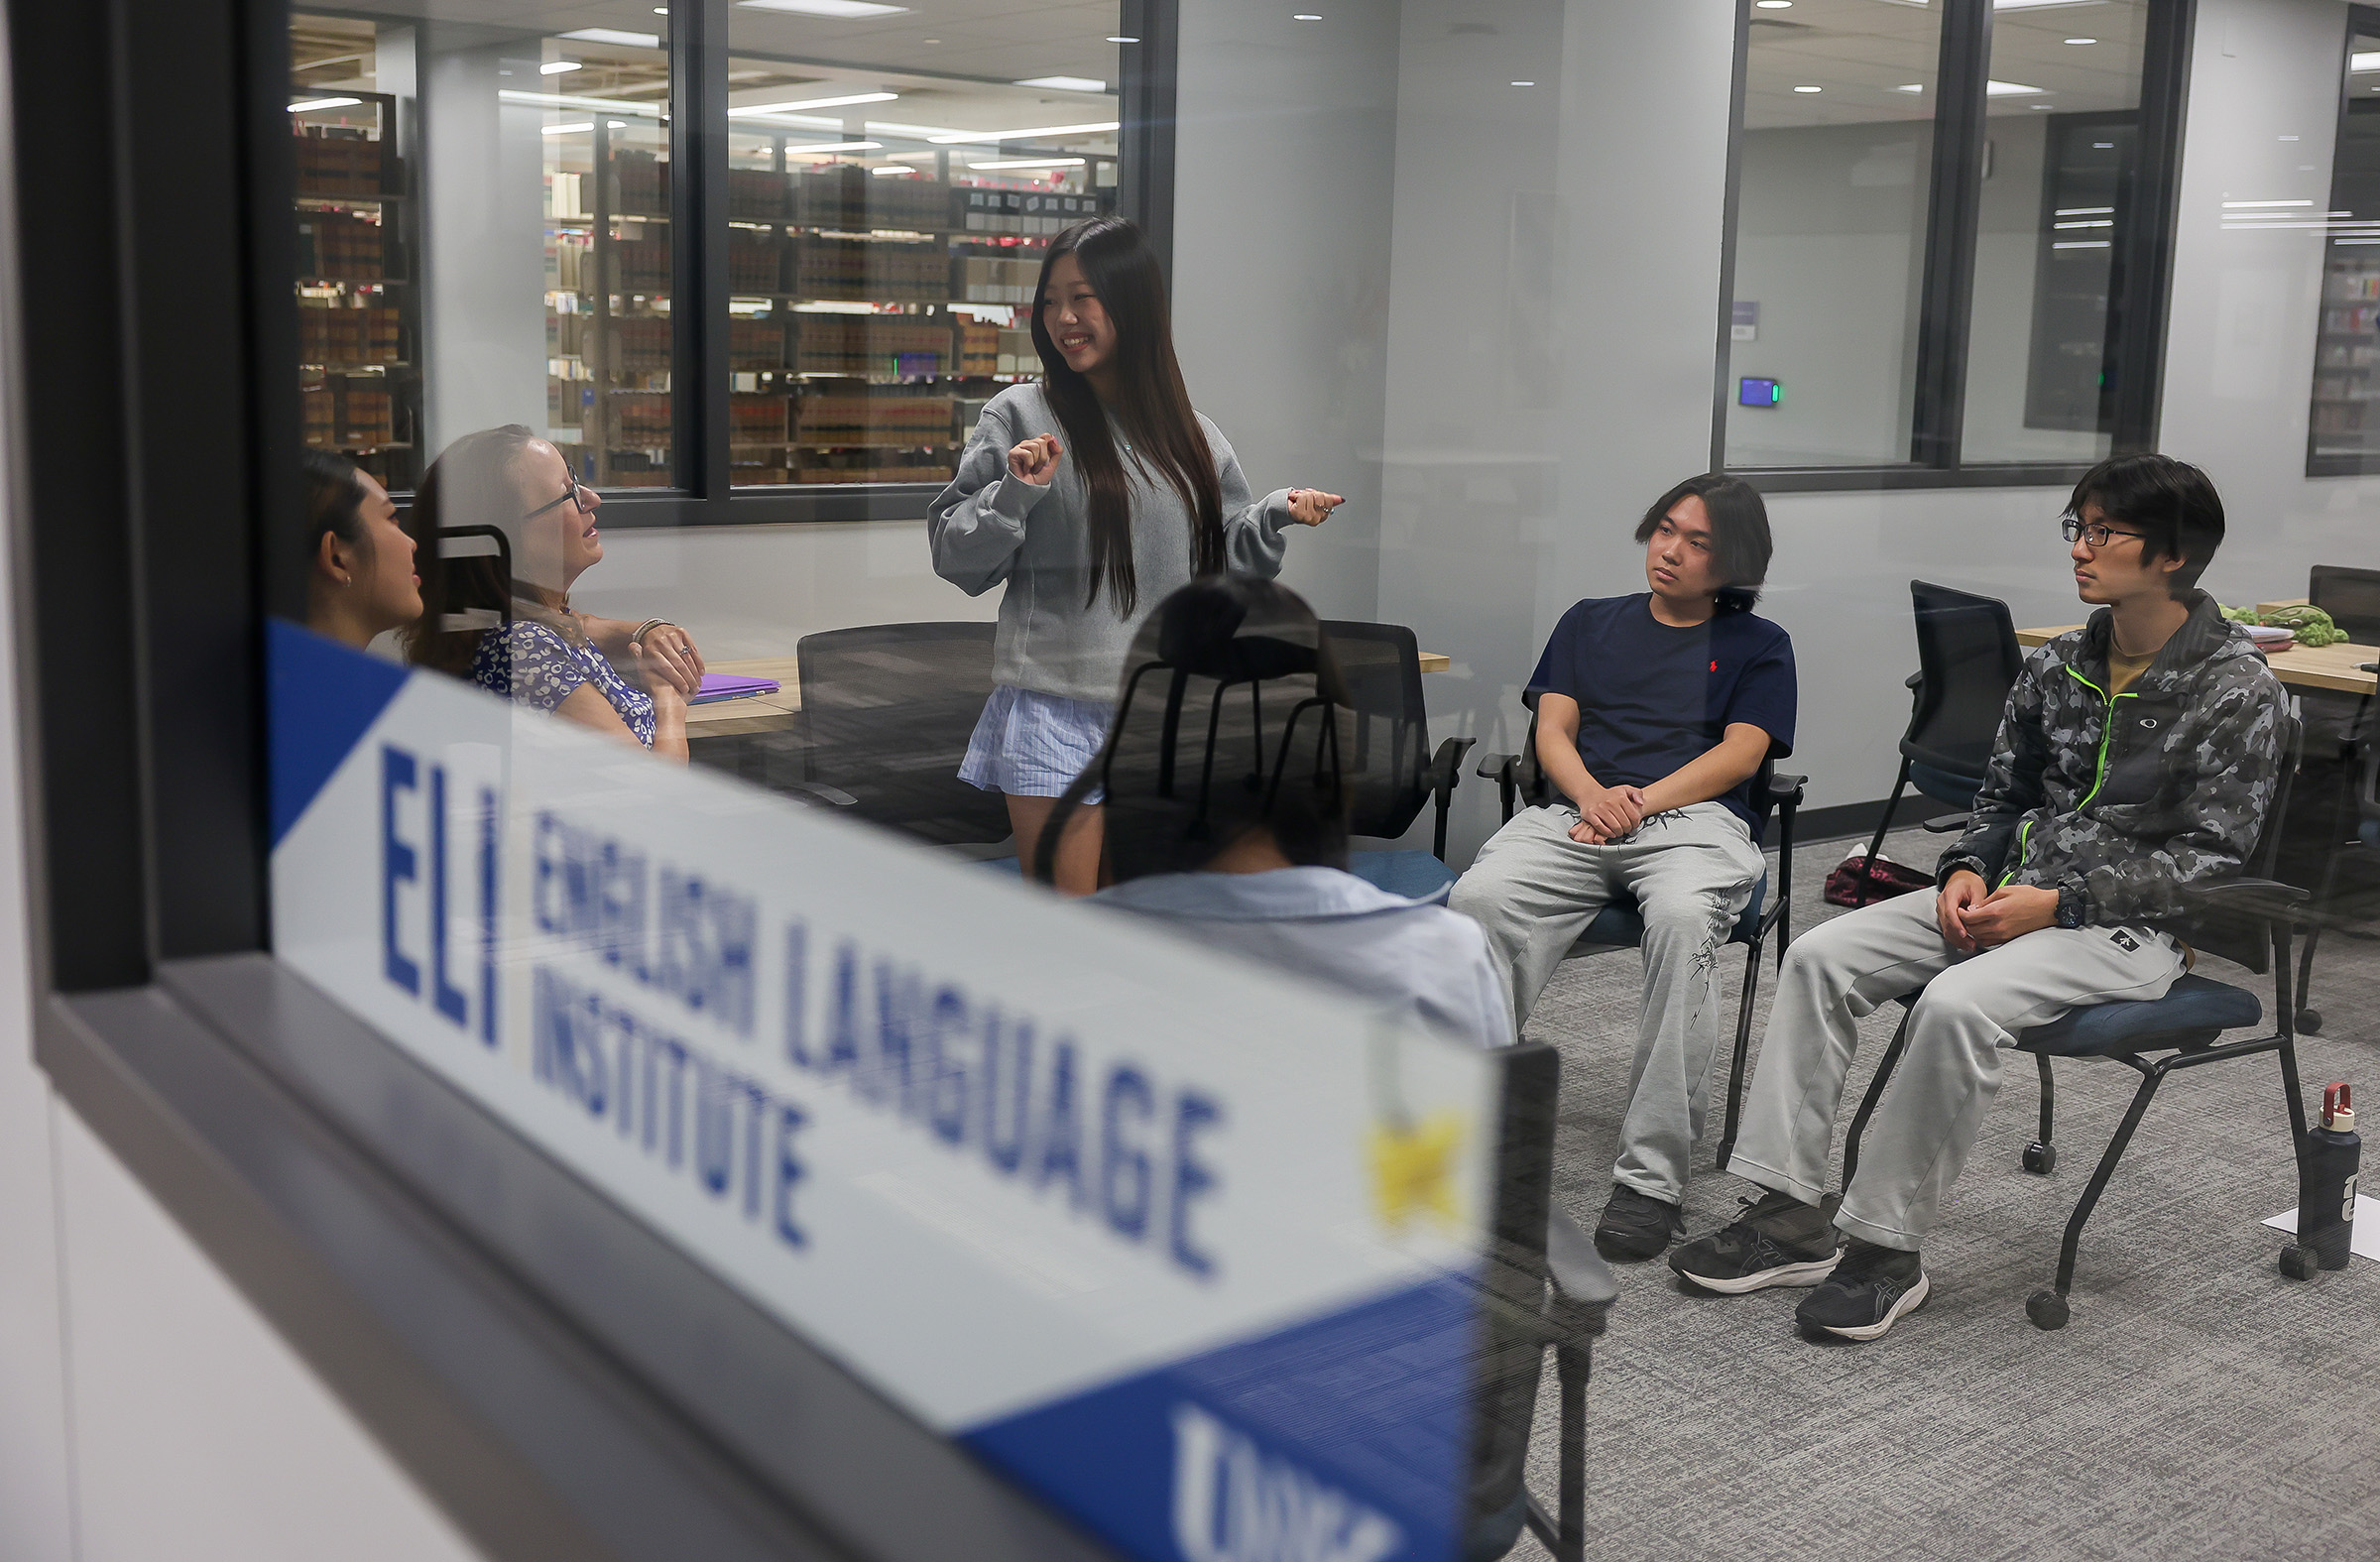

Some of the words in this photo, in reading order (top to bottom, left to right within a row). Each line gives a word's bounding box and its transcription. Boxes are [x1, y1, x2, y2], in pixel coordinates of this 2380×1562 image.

[380, 741, 503, 1051] ELI
[533, 809, 760, 1042] ENGLISH
[784, 914, 1222, 1281] LANGUAGE
[533, 965, 815, 1253] INSTITUTE
